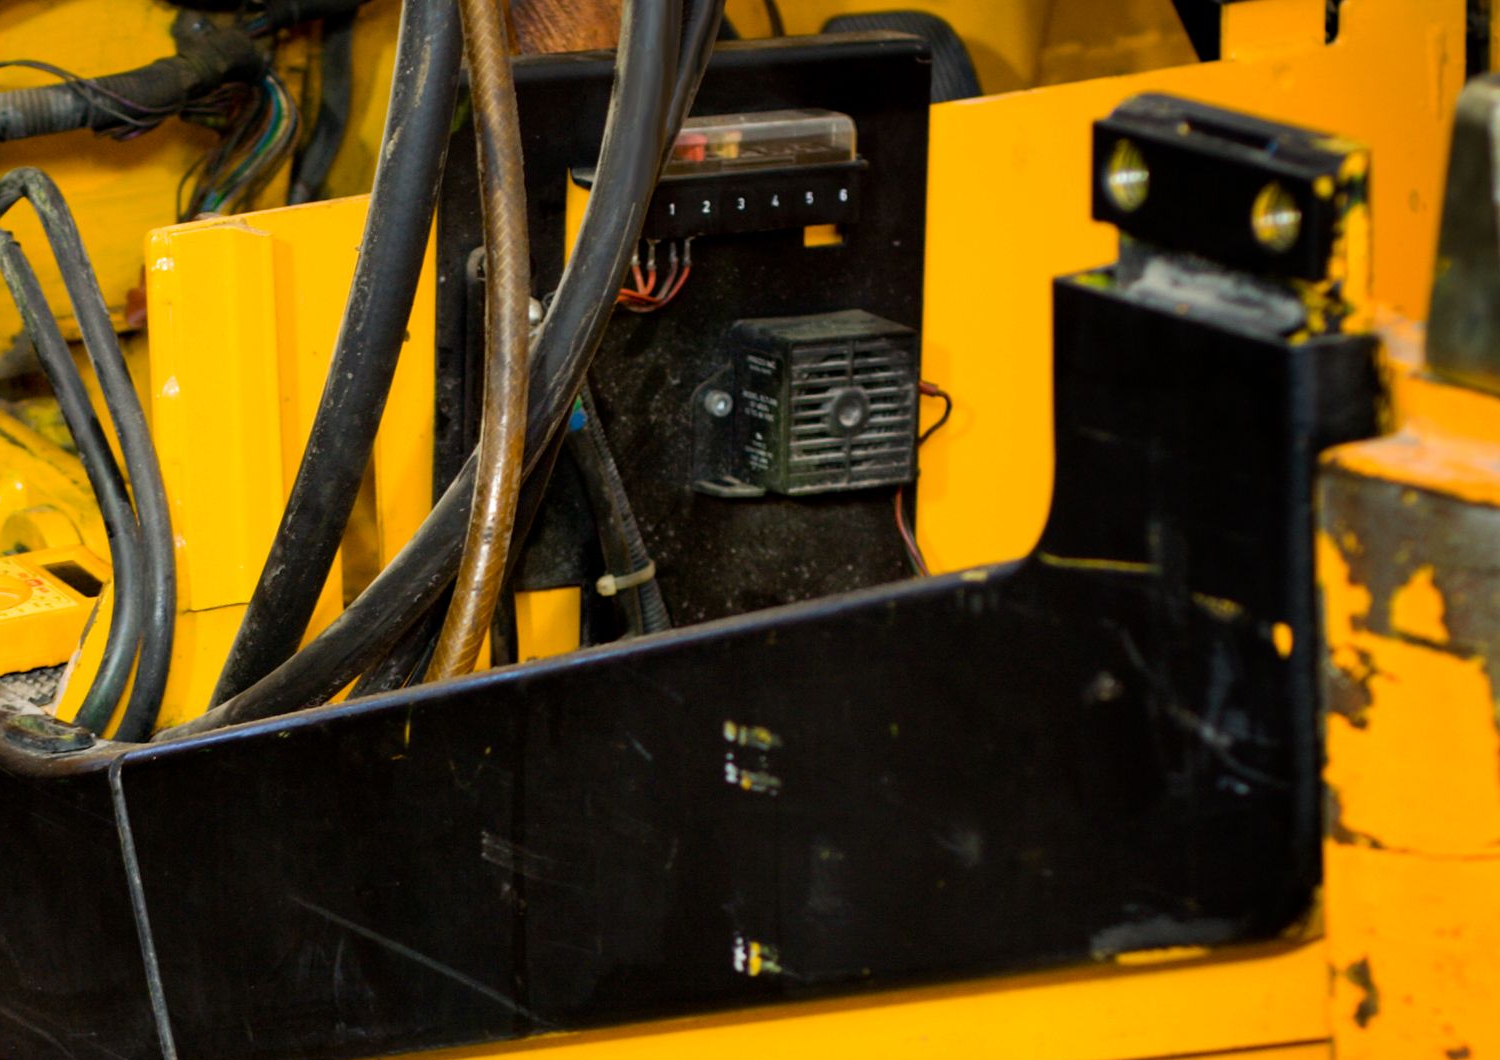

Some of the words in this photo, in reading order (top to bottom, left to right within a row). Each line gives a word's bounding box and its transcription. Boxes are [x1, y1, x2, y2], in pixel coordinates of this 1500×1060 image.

[669, 203, 675, 215] 1
[702, 200, 711, 213] 2
[737, 197, 745, 210] 3
[771, 194, 779, 207] 4
[805, 191, 813, 204] 5
[839, 188, 847, 202] 6
